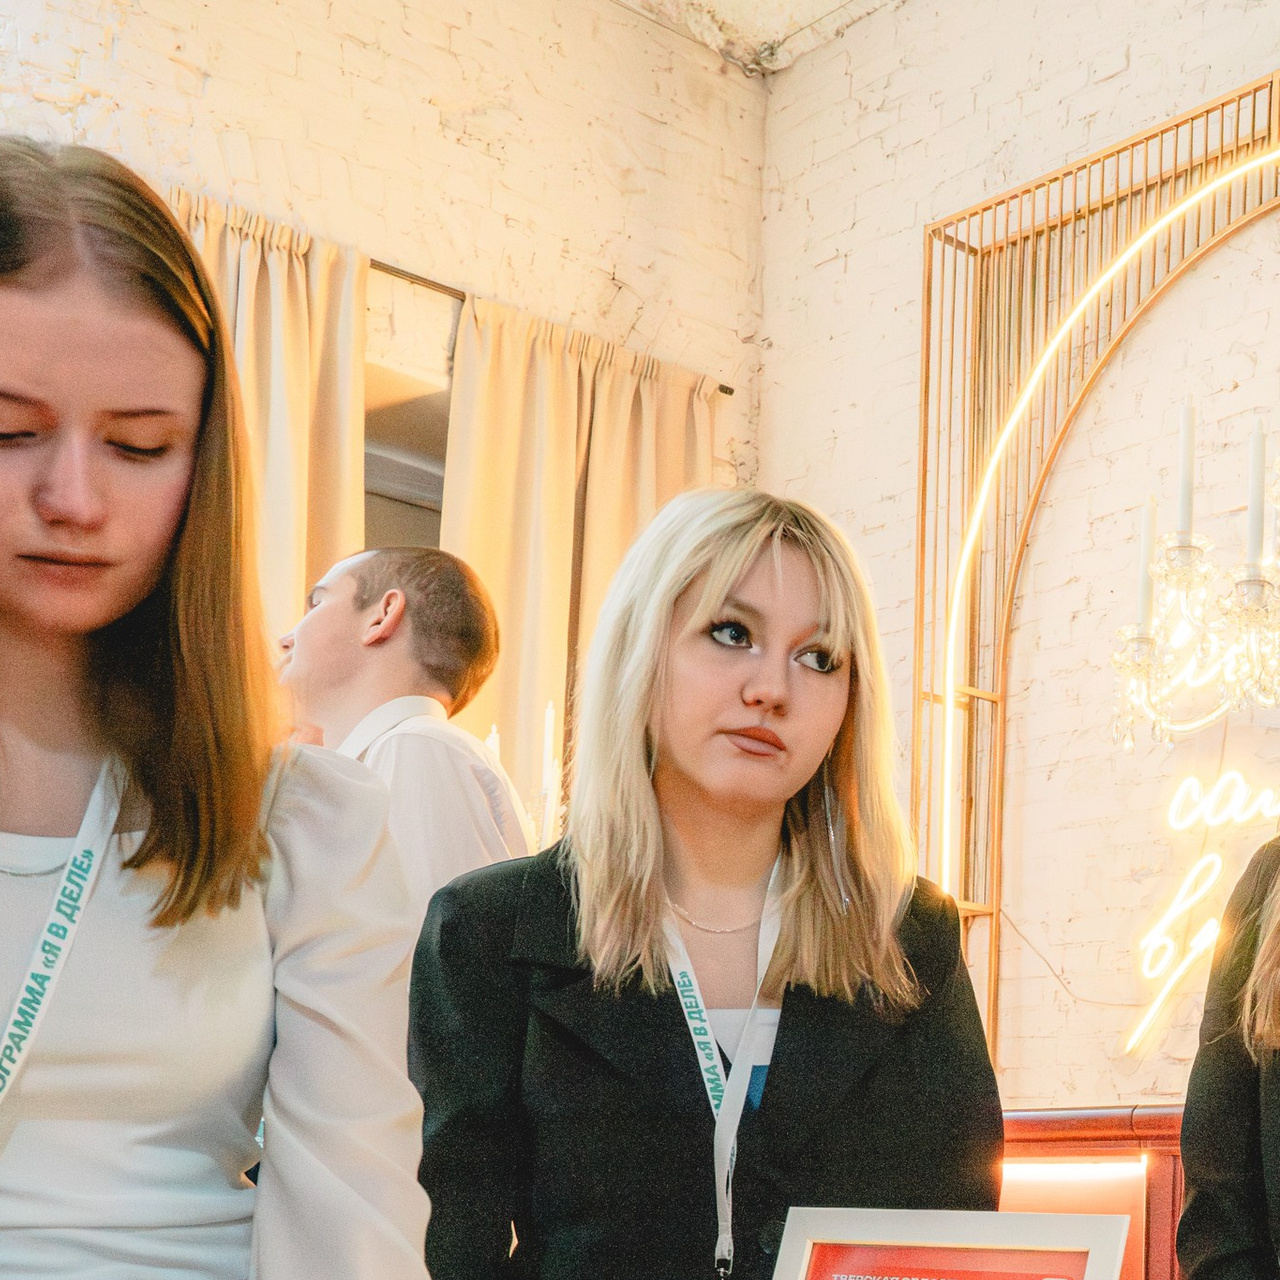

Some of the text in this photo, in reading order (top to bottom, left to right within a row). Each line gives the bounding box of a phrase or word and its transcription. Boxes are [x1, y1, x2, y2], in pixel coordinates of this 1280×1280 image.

[55, 849, 94, 925] ДЕЛЕ»
[48, 922, 68, 941] В
[677, 971, 707, 1023] ДЕЛЕ»
[0, 972, 51, 1093] ОГРАММА
[693, 1026, 708, 1037] В
